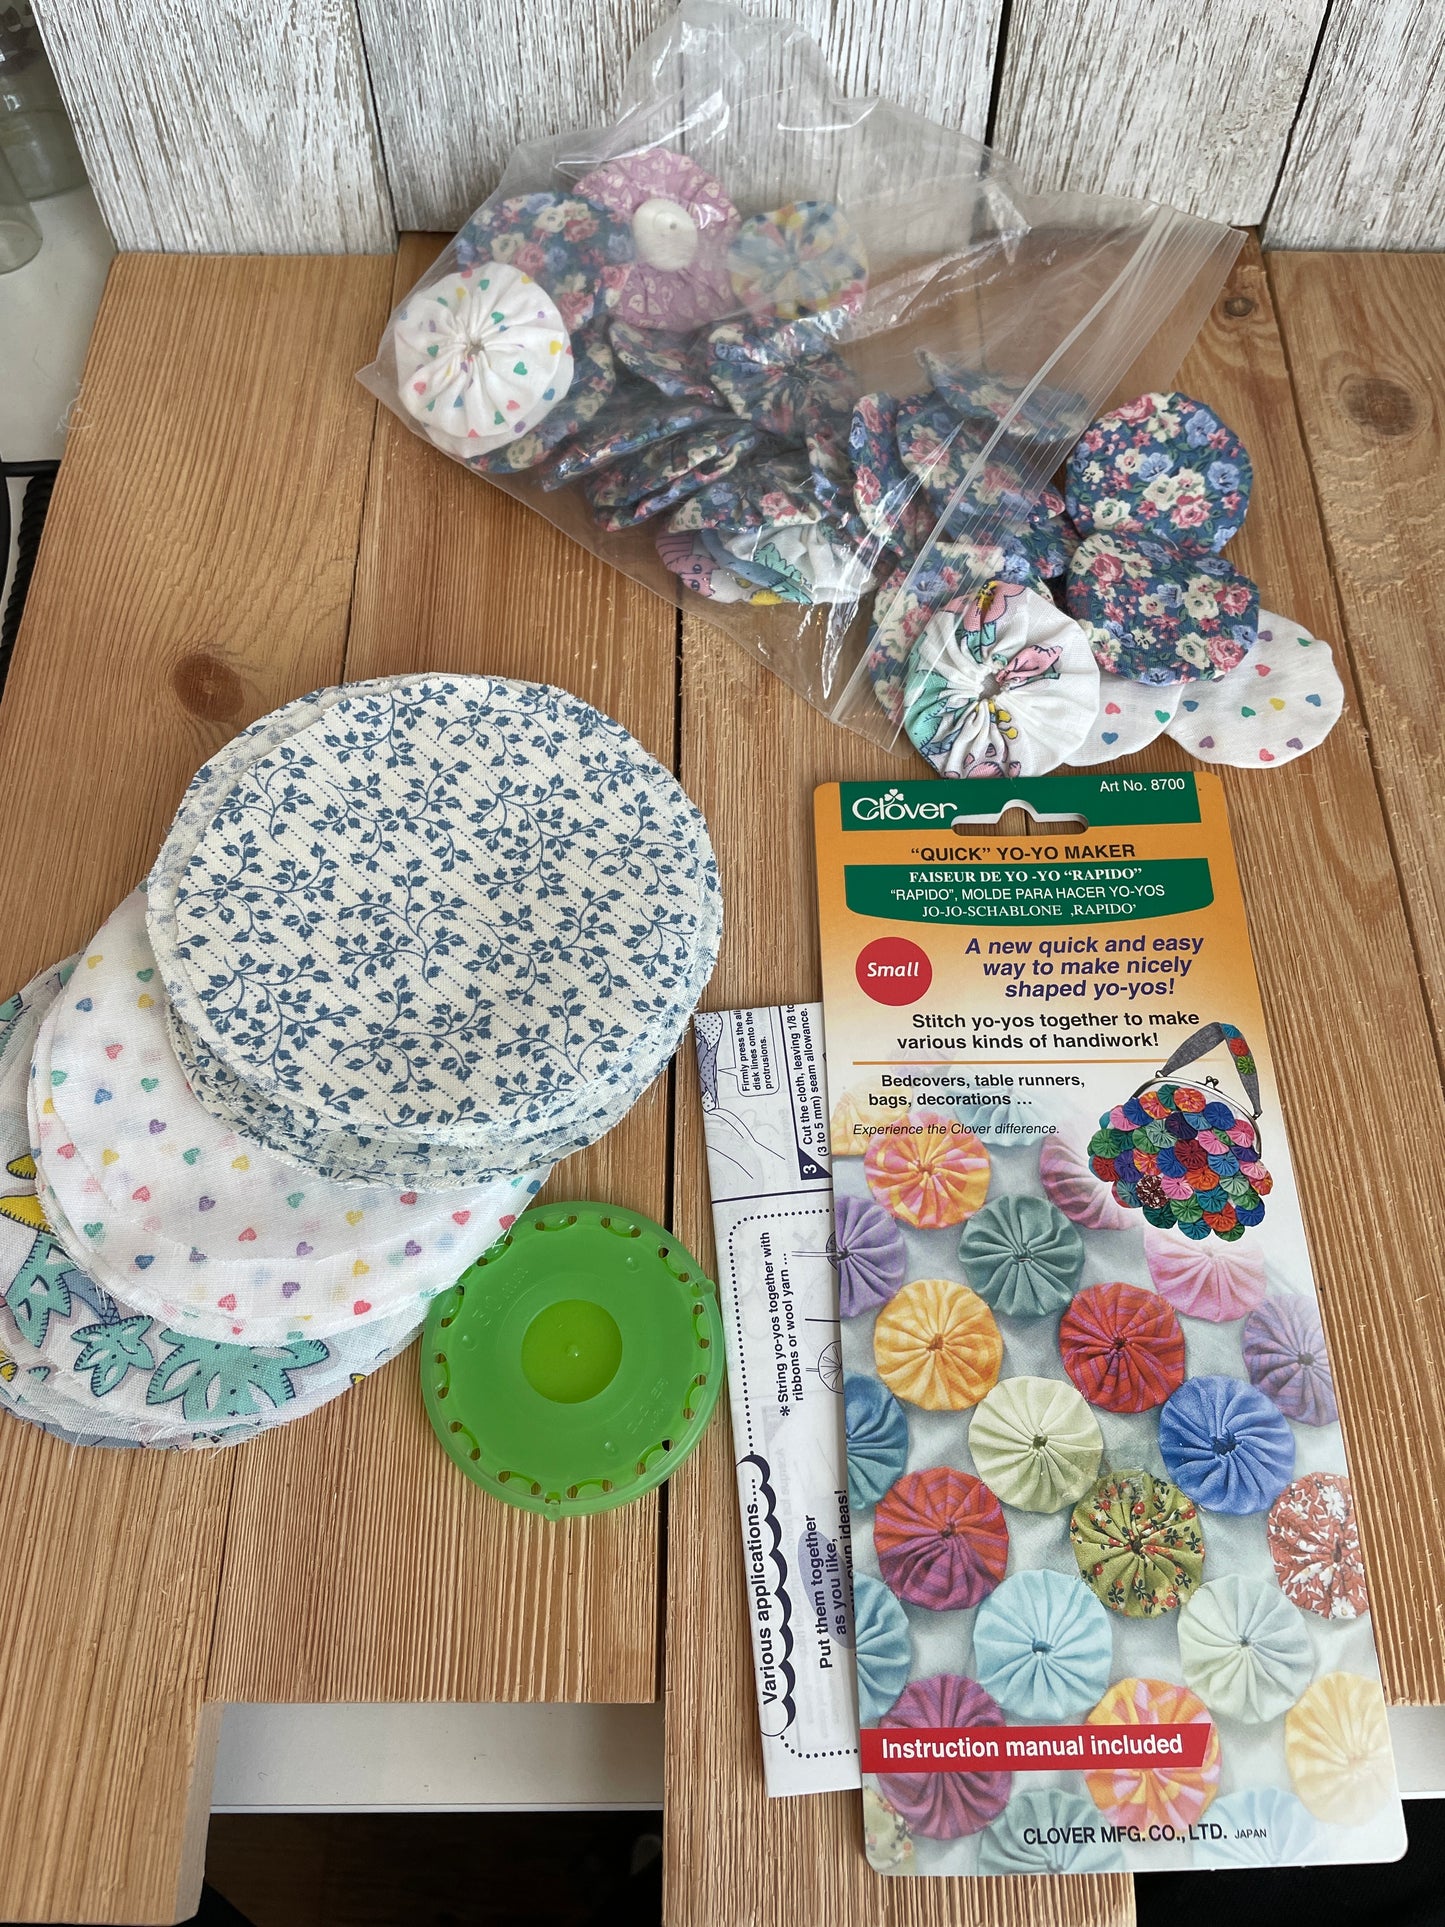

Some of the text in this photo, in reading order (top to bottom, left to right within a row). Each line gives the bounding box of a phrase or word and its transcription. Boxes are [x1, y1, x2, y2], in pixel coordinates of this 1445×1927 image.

[1100, 778, 1185, 792] Art No. 8700
[852, 797, 958, 821] Clover
[911, 844, 1135, 862] “QUICK” YO-YO MAKER
[909, 871, 976, 883] FAISEUR
[980, 871, 1001, 882] DE
[1064, 868, 1142, 881] “RAPIDO”
[890, 885, 1165, 902] “RAPIDO”, MOLDE PARA HACER YO-YOS
[922, 904, 1062, 918] JO-JO-SCHABLONE
[965, 935, 1204, 958] A new quick and easy
[867, 962, 919, 977] Small
[983, 956, 1192, 980] way to make nicely
[1005, 978, 1175, 1001] shaped yo-yos!
[735, 1022, 744, 1035] the
[912, 1011, 1200, 1031] Stitch yo-yos together to make
[800, 1008, 815, 1062] allowance.
[897, 1032, 1159, 1049] various kinds of handiwork!
[737, 1037, 748, 1062] press
[745, 1011, 761, 1091] disk lines onto the
[759, 1036, 774, 1089] protrusions.
[786, 1004, 812, 1144] Cut the cloth, leaving 1/8 to
[740, 1064, 750, 1092] Firmly
[807, 1064, 819, 1093] seam
[881, 1074, 1085, 1089] Bedcovers, table runners,
[810, 1096, 822, 1119] mm)
[868, 1093, 912, 1109] bags,
[917, 1092, 1011, 1106] decorations
[816, 1132, 825, 1143] to
[853, 1122, 1060, 1137] Experience the Clover difference.
[818, 1146, 829, 1156] (3
[803, 1163, 817, 1174] 3
[780, 1269, 793, 1296] yarn
[760, 1232, 788, 1402] String yo-yos together with
[782, 1301, 795, 1331] wool
[788, 1334, 797, 1347] or
[790, 1351, 803, 1401] ribbons
[834, 1490, 850, 1539] ideas!
[805, 1515, 832, 1668] Put them together
[826, 1538, 846, 1634] as you like,
[759, 1628, 777, 1704] Various
[881, 1734, 1183, 1758] Instruction manual included
[1023, 1827, 1096, 1845] CLOVER
[1100, 1826, 1146, 1843] MFG.
[1189, 1823, 1228, 1841] LTD.
[1234, 1828, 1267, 1839] JAPAN
